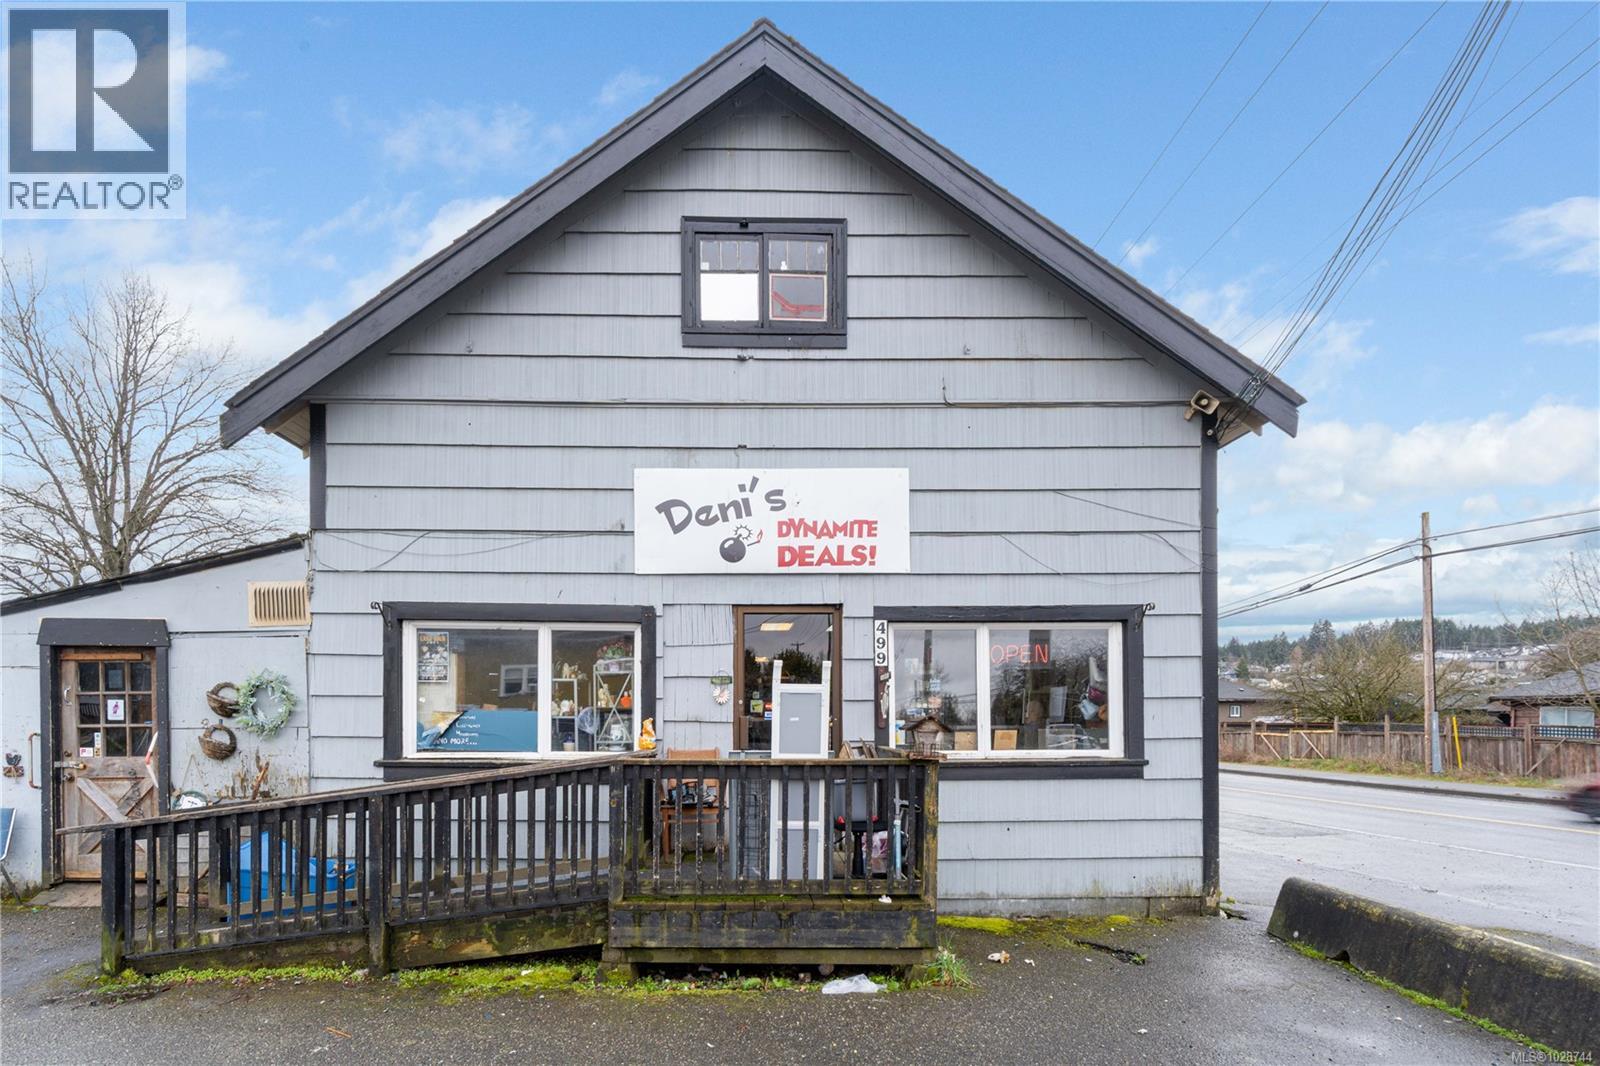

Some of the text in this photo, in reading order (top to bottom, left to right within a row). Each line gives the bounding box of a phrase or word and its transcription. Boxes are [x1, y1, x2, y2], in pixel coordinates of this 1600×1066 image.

[654, 475, 788, 536] Deni's
[777, 518, 879, 540] DYNAMITE
[777, 545, 878, 568] DEALS!
[876, 621, 887, 665] 499
[990, 642, 1049, 664] OPEN
